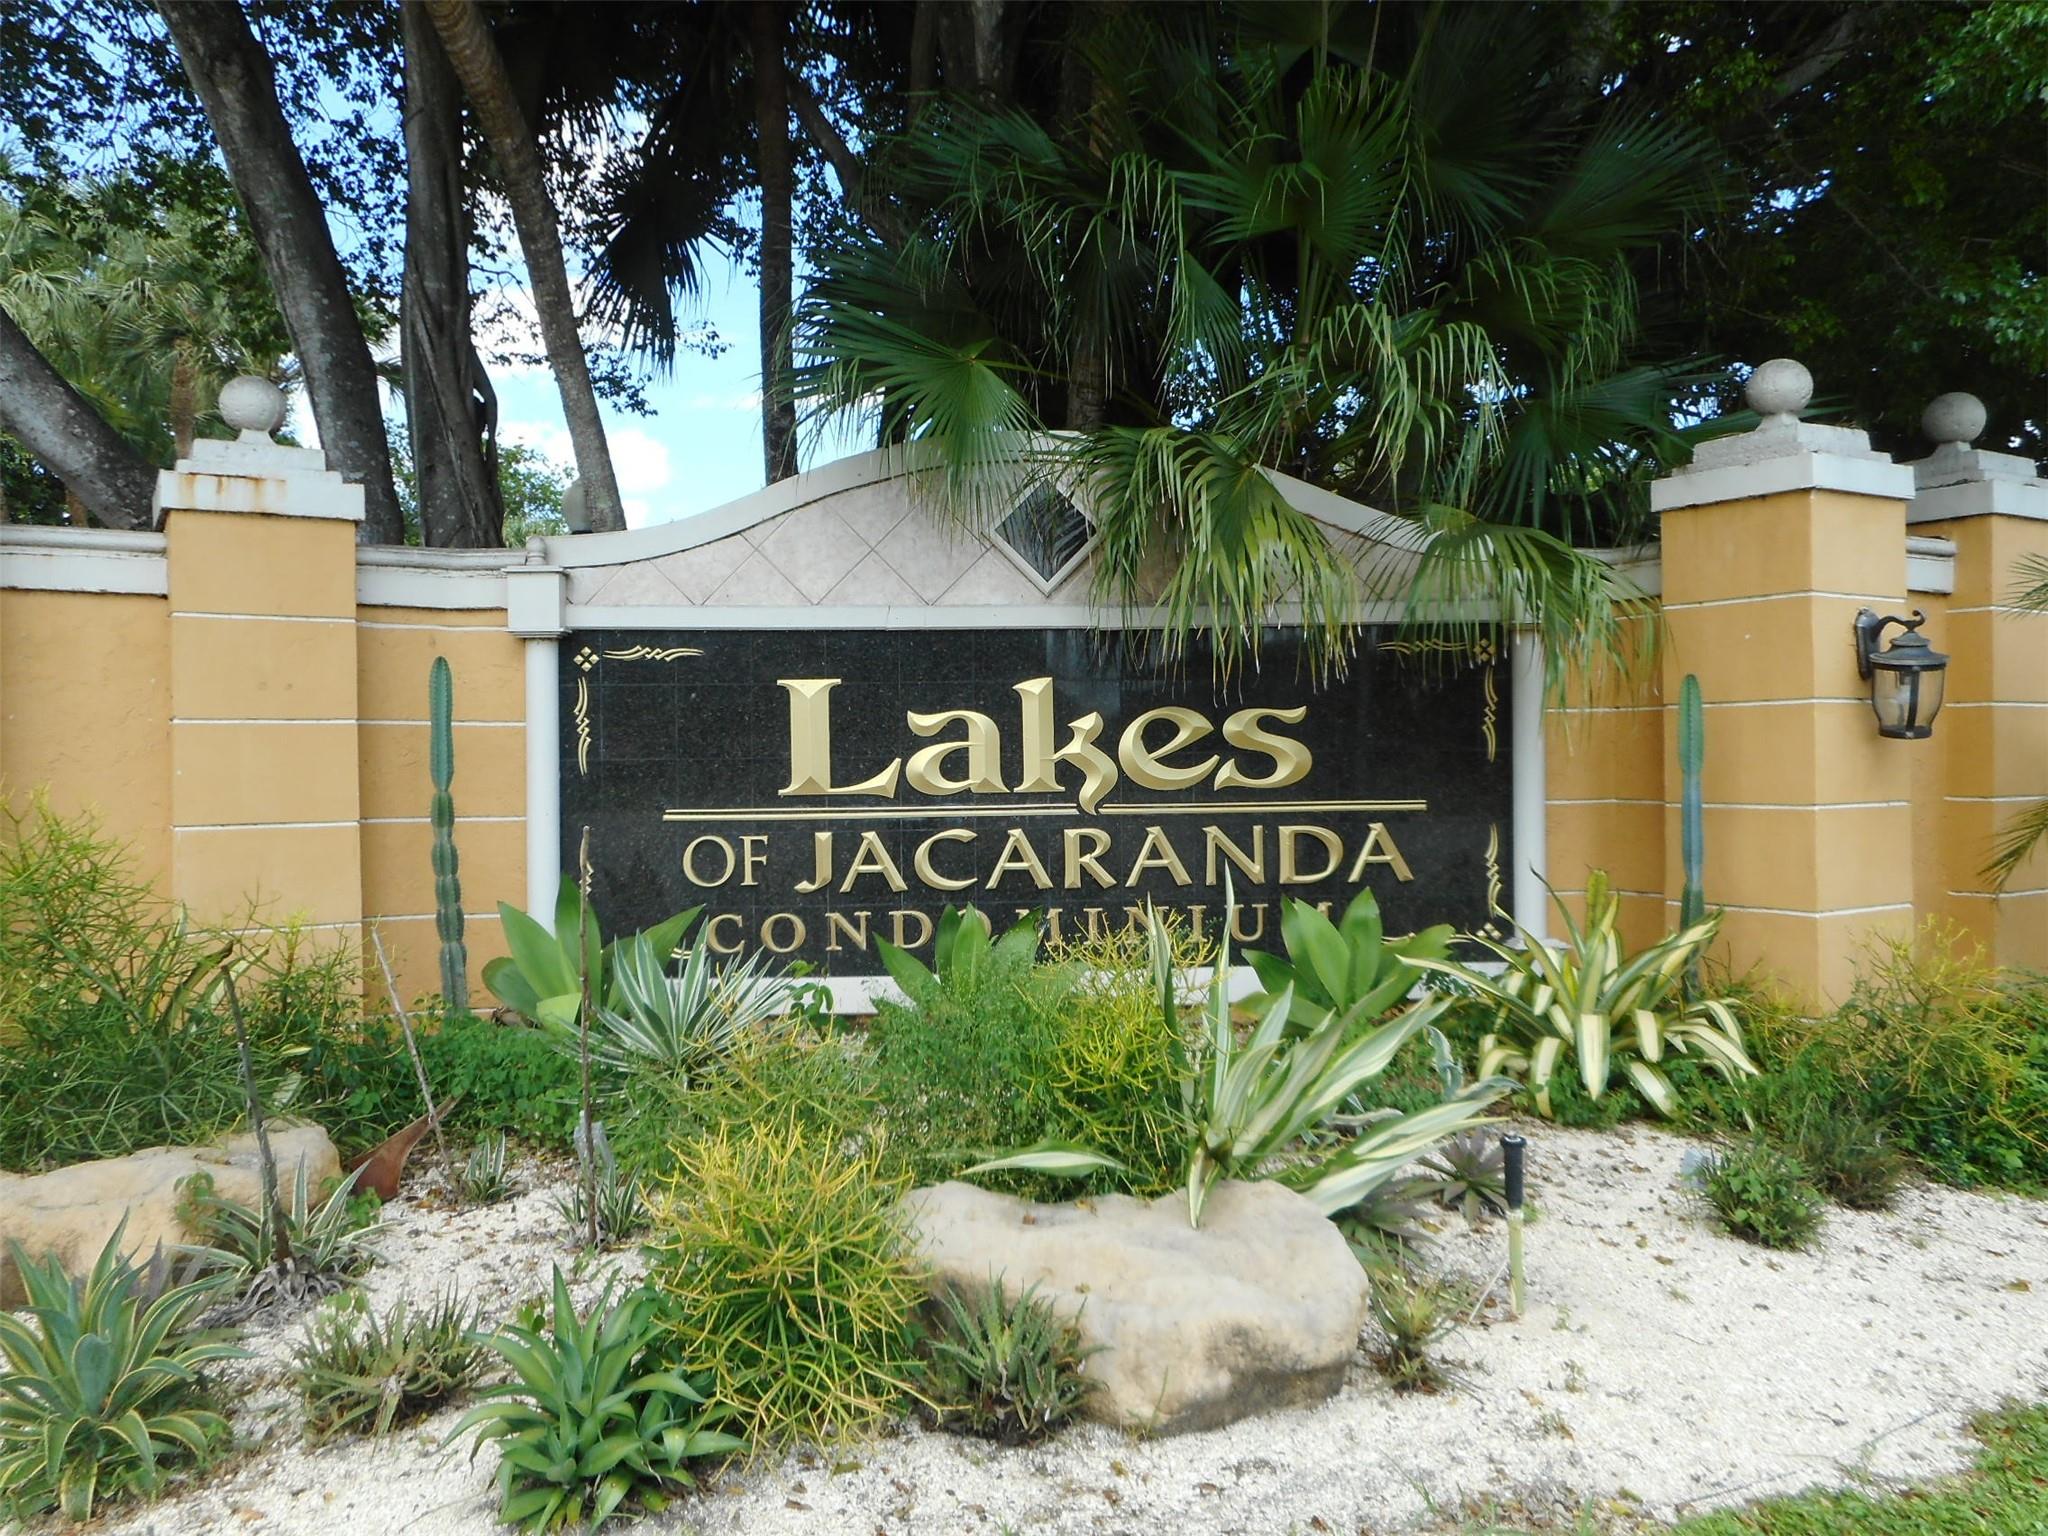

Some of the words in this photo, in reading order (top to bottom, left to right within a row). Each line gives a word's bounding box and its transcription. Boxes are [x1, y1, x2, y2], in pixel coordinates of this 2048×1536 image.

[777, 677, 1313, 815] Lakes
[683, 835, 768, 888] OF
[795, 822, 1414, 893] JACARANDA
[706, 902, 1334, 953] CONDINIU
